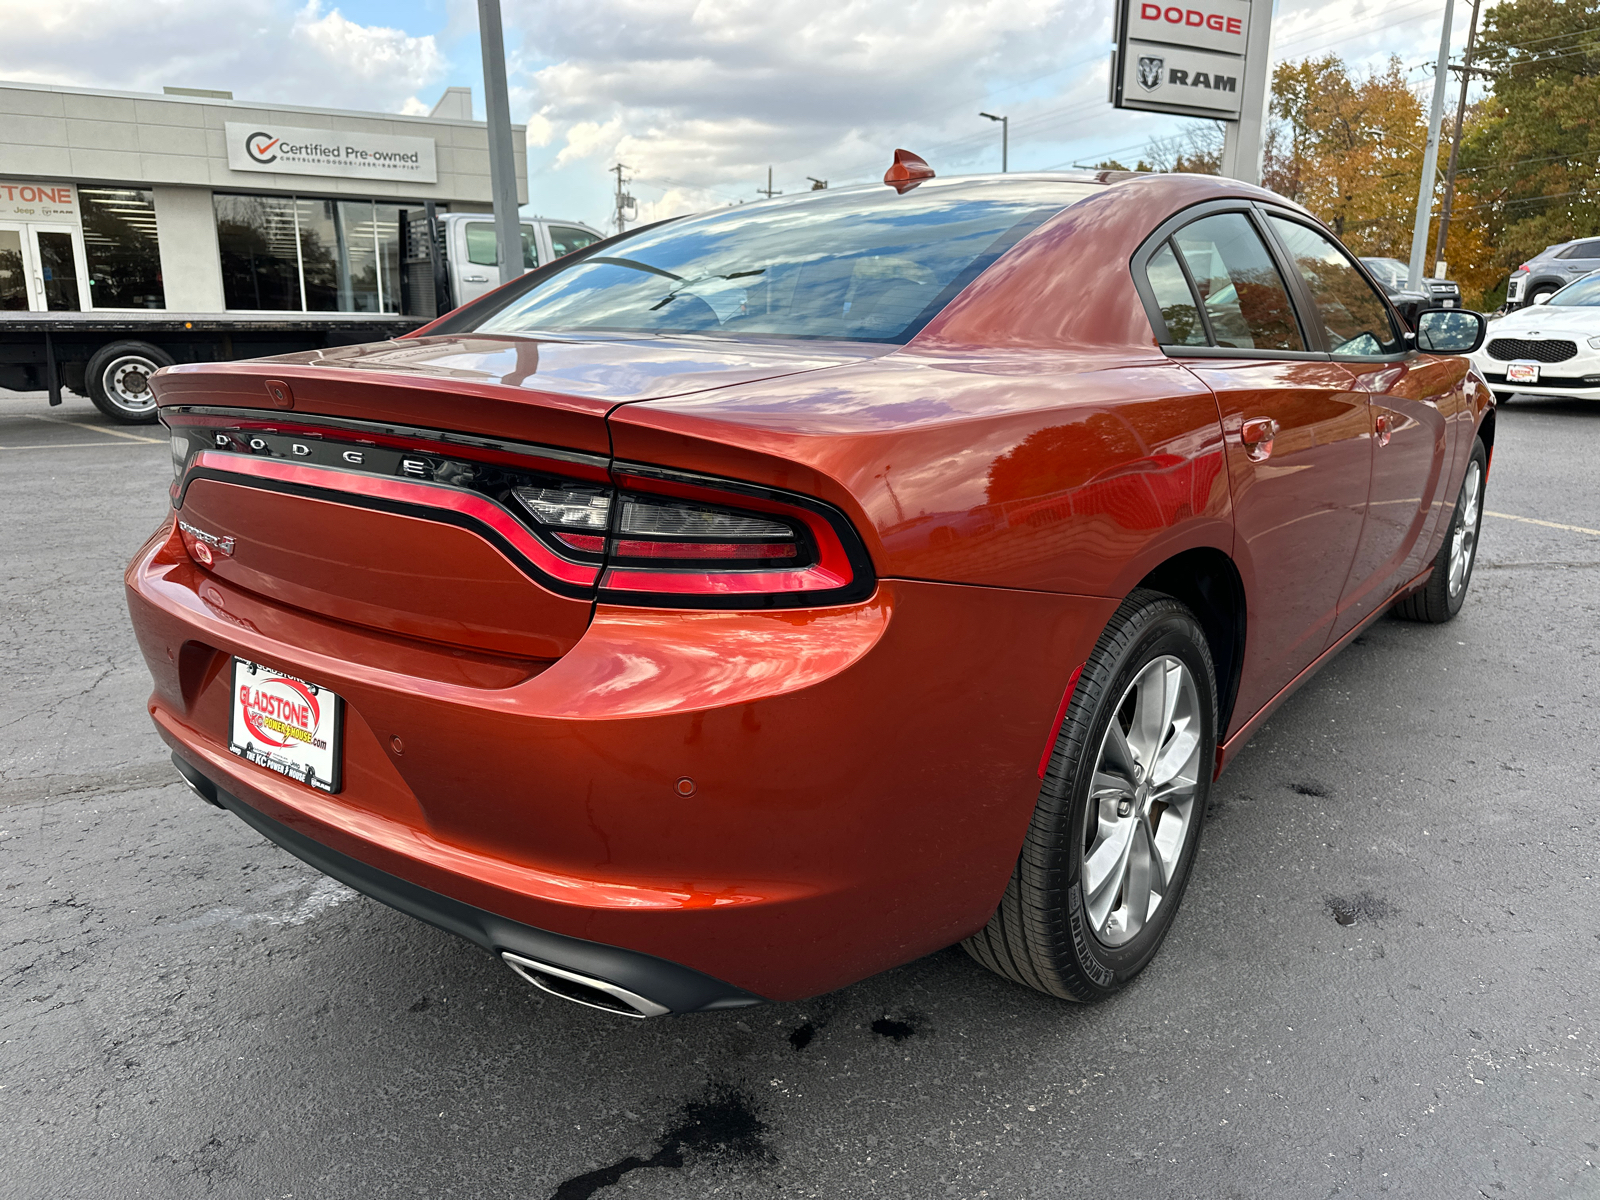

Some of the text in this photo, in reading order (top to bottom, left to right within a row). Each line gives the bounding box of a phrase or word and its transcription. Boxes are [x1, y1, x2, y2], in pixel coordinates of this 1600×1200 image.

[1140, 3, 1243, 35] DODGE
[1168, 68, 1237, 93] RAM
[279, 142, 419, 164] Certified Pre-owned
[0, 185, 73, 204] TONE
[13, 206, 36, 216] Jeep
[215, 434, 425, 475] DODGE
[239, 684, 309, 729] GLADSTONE
[249, 711, 264, 728] KC
[264, 716, 287, 734] POWER
[229, 743, 242, 756] Jeep
[246, 750, 256, 762] THE
[255, 752, 267, 768] KC
[267, 759, 286, 775] POWER
[1070, 915, 1105, 983] MICHELIN
